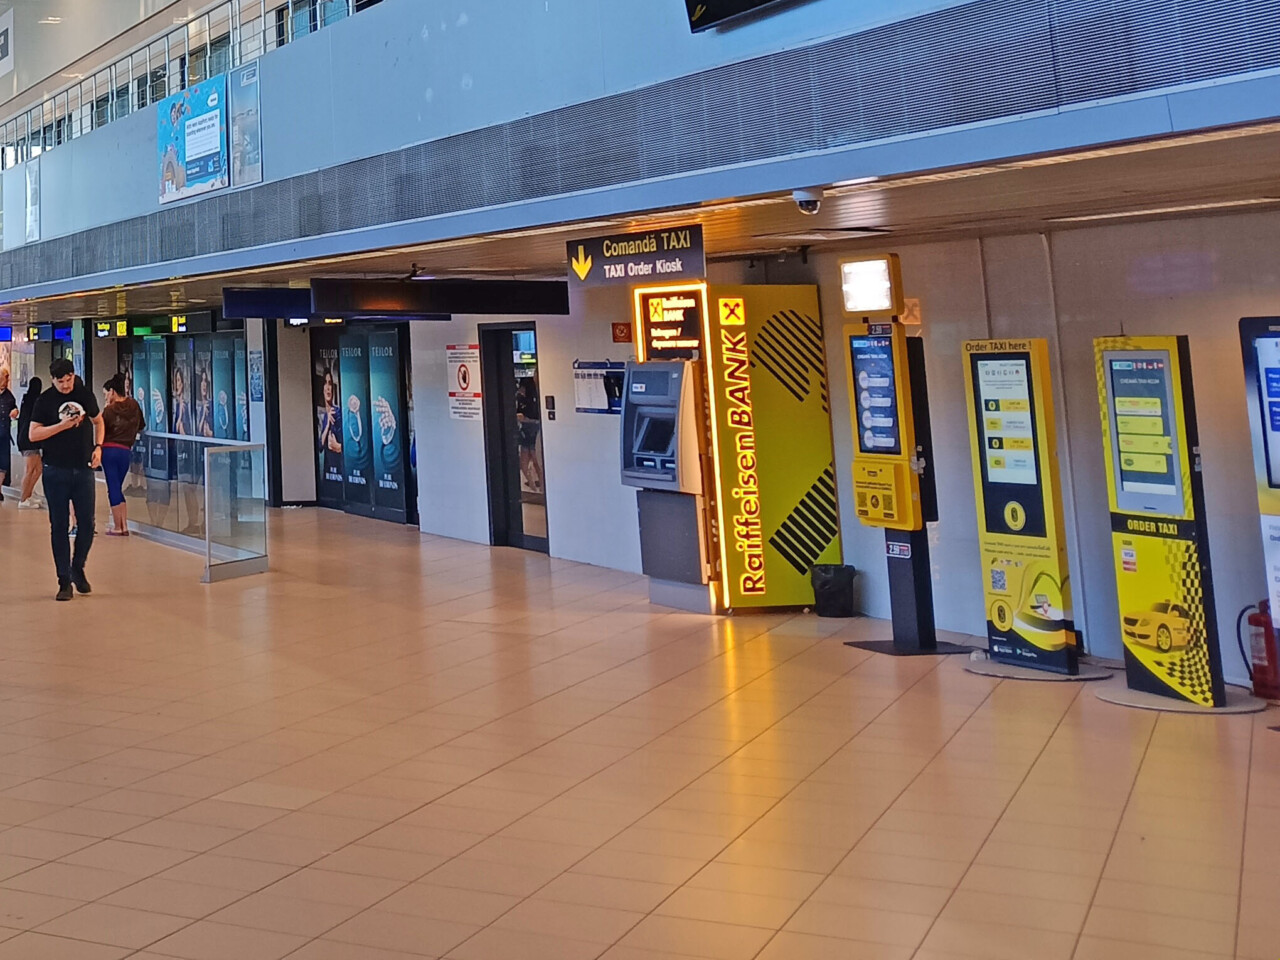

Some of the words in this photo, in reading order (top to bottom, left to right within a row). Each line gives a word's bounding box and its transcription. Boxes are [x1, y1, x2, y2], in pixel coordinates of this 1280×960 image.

[603, 234, 657, 257] Comandă
[661, 230, 691, 250] TAXI
[604, 263, 625, 278] TAXI
[627, 261, 654, 277] Order
[656, 258, 683, 273] Kiosk
[966, 341, 987, 352] Order
[989, 342, 1007, 351] TAXI
[1008, 341, 1027, 350] here
[721, 329, 754, 429] BANK
[732, 432, 766, 594] Raiffeisen
[1127, 519, 1157, 533] ORDER
[1157, 522, 1178, 535] TAXI
